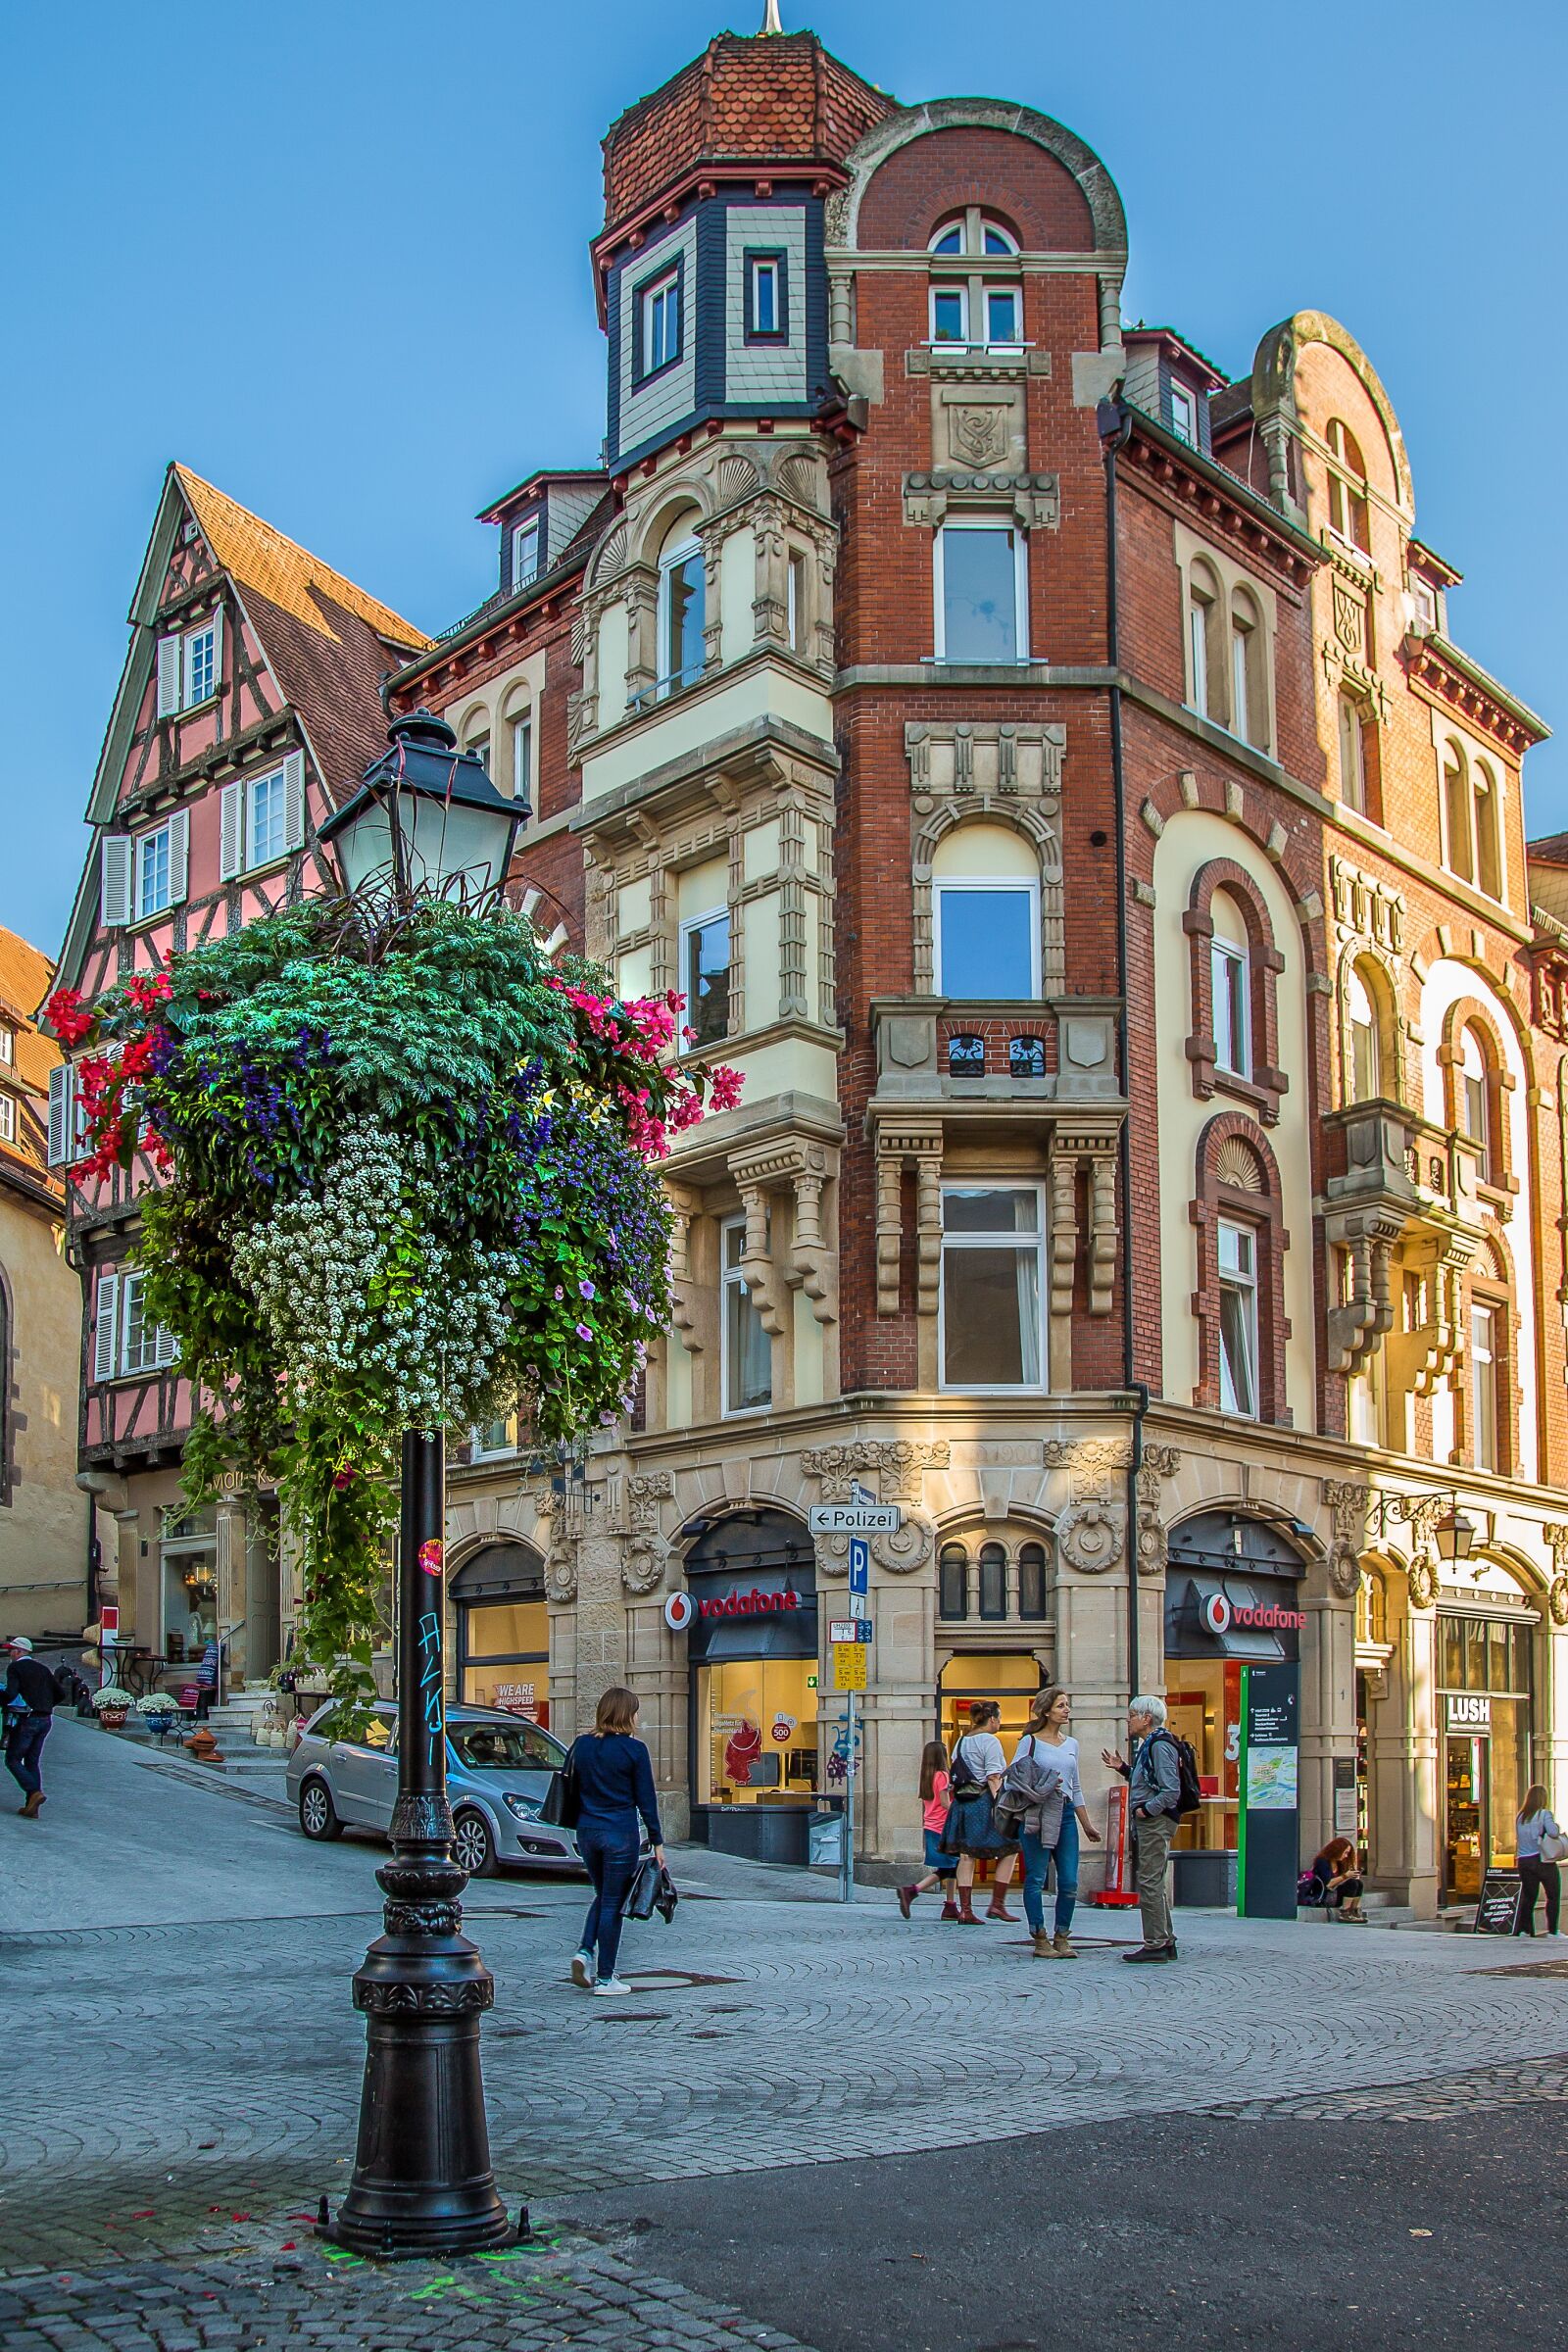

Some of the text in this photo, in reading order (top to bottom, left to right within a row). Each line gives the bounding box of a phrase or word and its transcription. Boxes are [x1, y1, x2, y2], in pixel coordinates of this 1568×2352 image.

[834, 1511, 892, 1526] Polizei
[854, 1545, 864, 1586] P
[698, 1588, 799, 1617] vodafone
[1233, 1602, 1308, 1629] vodafone
[499, 1684, 534, 1695] WE ARE
[499, 1696, 534, 1705] HIGHSPEED
[1448, 1697, 1490, 1722] LUSH
